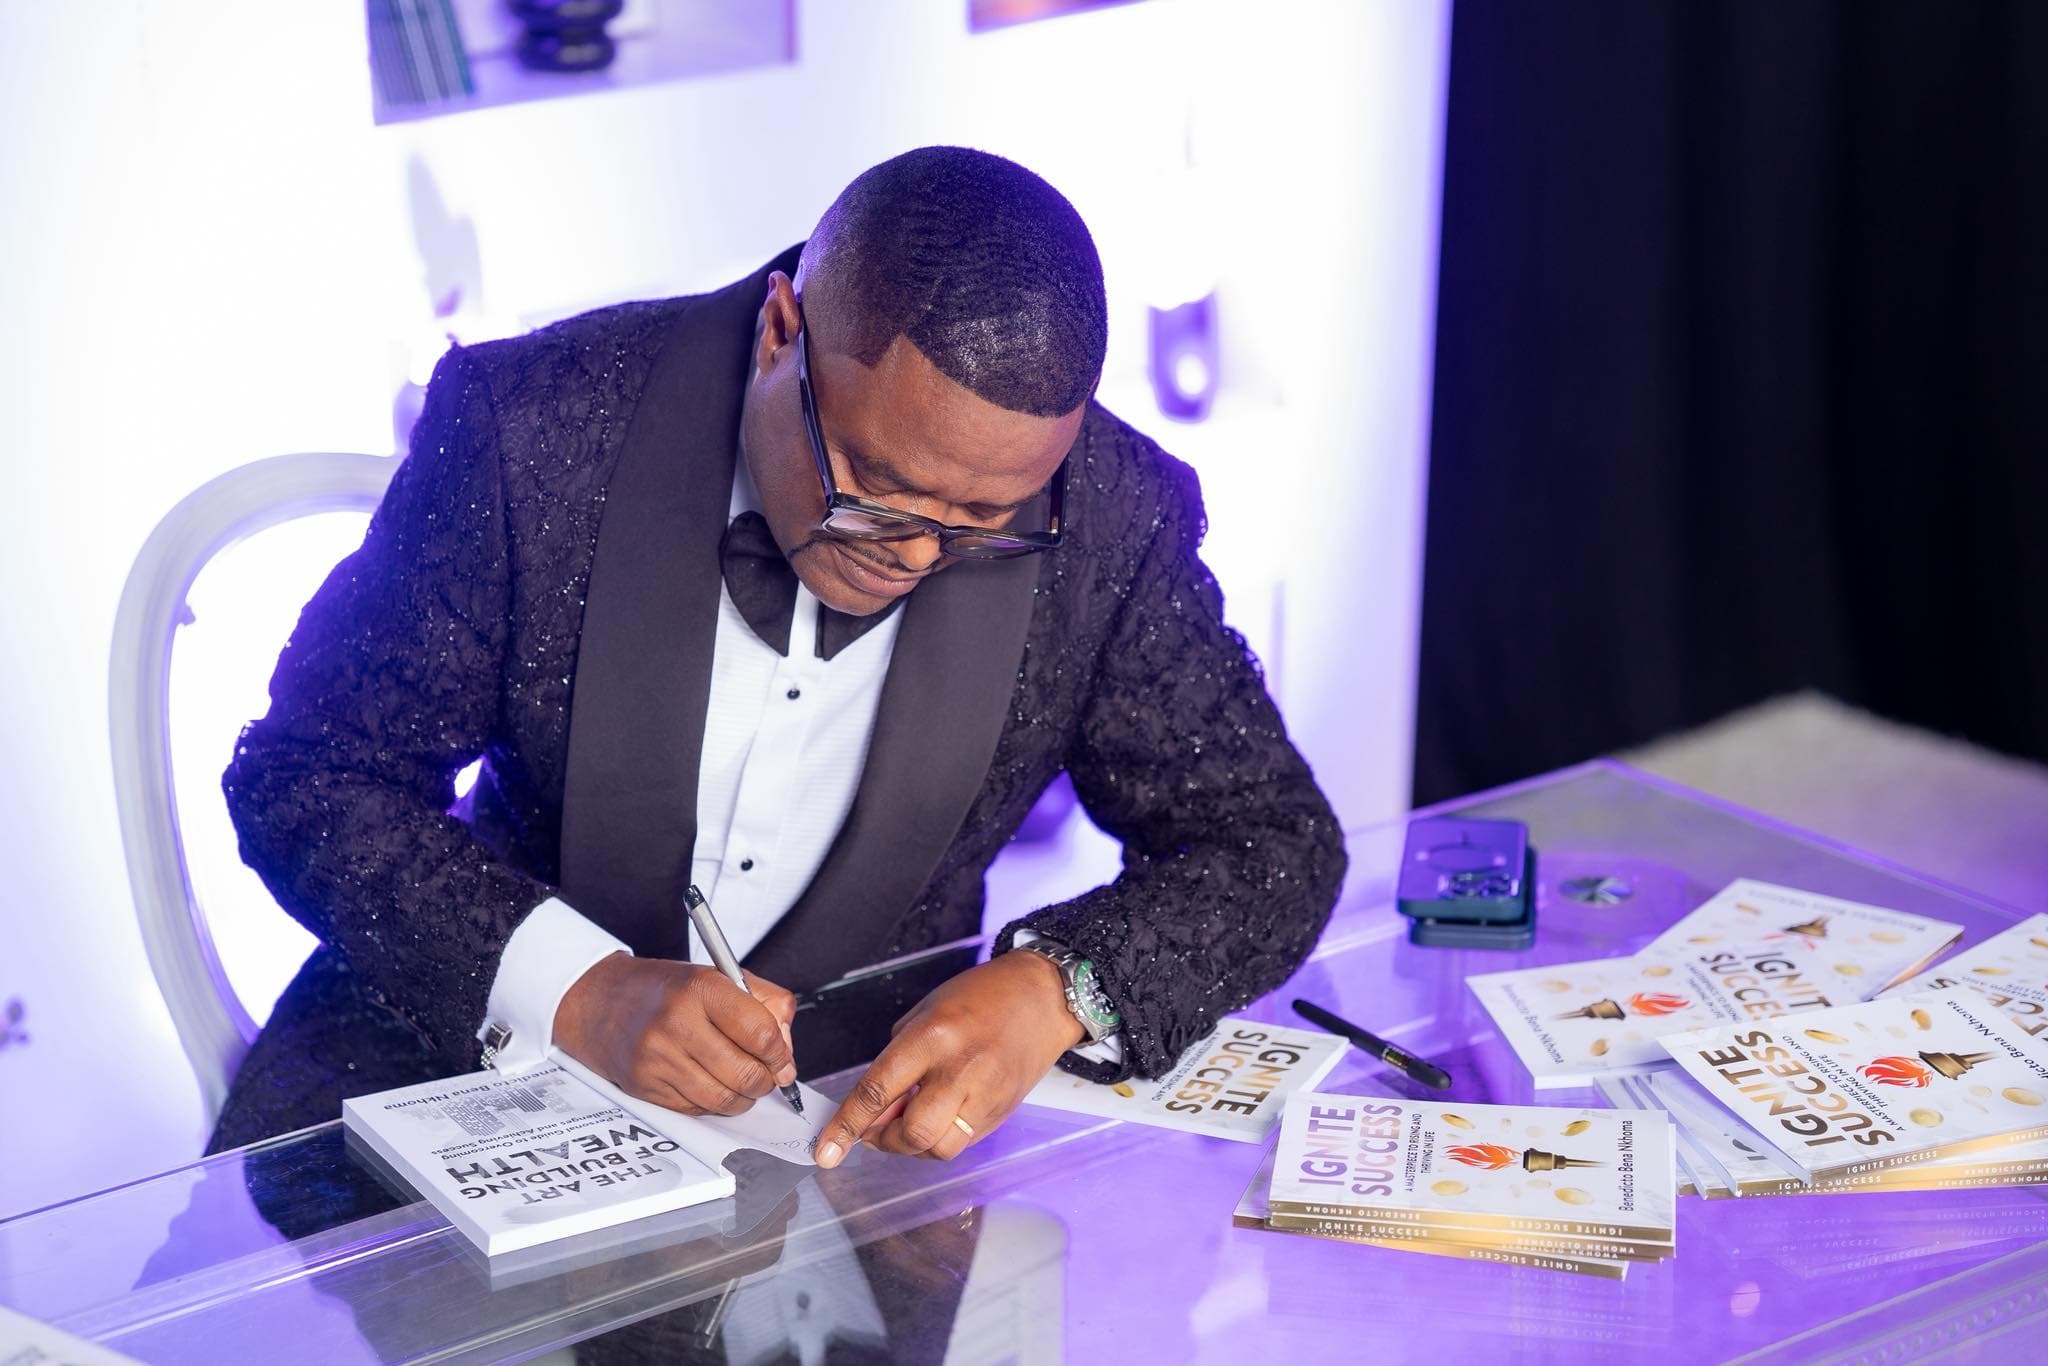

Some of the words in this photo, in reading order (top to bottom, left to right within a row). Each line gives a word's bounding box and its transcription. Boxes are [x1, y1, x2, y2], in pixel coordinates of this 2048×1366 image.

[1700, 953, 1790, 1020] SUCCE
[1745, 952, 1833, 1008] IGNIT
[1947, 1001, 1995, 1037] Nkhoma
[1782, 1035, 1804, 1051] AND
[1994, 1037, 2025, 1058] Bena
[1800, 1051, 1830, 1074] RISING
[1818, 1054, 1839, 1069] LIFE
[1165, 1029, 1268, 1114] SUCCESS
[1210, 1041, 1310, 1115] IGNITE
[1827, 1074, 1842, 1084] TO
[1835, 1068, 1849, 1078] IN
[452, 1085, 491, 1096] Bena
[1699, 1045, 1847, 1146] IGNITE
[1734, 1030, 1895, 1146] SUCCESS
[1846, 1076, 1889, 1108] THRIVING
[383, 1093, 450, 1111] Nkhoma
[1839, 1083, 1898, 1126] MASTERPIECE
[561, 1107, 622, 1126] Challenges
[567, 1116, 614, 1133] Personal
[1412, 1113, 1422, 1125] AND
[478, 1128, 534, 1144] Achieving
[530, 1130, 564, 1141] Guide
[538, 1123, 558, 1132] and
[1410, 1125, 1421, 1143] RISING
[1424, 1131, 1435, 1142] LIFE
[1618, 1120, 1633, 1152] Nkhoma
[2009, 1129, 2048, 1143] BENEDIC
[431, 1140, 477, 1156] Success
[441, 1141, 514, 1161] Overcoming
[446, 1124, 658, 1183] WEALTH
[634, 1140, 680, 1160] OF
[1299, 1106, 1356, 1186] IGNITE
[1351, 1103, 1403, 1196] SUCCESS
[1404, 1152, 1418, 1187] MASTERPIECE
[1420, 1149, 1433, 1174] THRIVING
[1618, 1153, 1633, 1172] Bena
[1846, 1160, 1884, 1174] IGNITE
[1890, 1150, 1937, 1166] SUCCESS
[2028, 1162, 2048, 1170] NKH
[459, 1152, 628, 1199] BUILDING
[590, 1163, 662, 1187] THE
[2003, 1175, 2048, 1183] NKHOMA
[521, 1180, 581, 1205] ART
[1618, 1173, 1634, 1212] Benedicto
[1358, 1209, 1421, 1220] BENEDICTO
[1319, 1221, 1364, 1232] IGNITE
[1371, 1225, 1429, 1237] SUCCESS
[1508, 1220, 1569, 1232] SUCCESS
[1576, 1224, 1623, 1236] IGNITE
[1469, 1249, 1526, 1264] SUCCESS
[1587, 1243, 1636, 1254] NKHOMA
[1534, 1258, 1579, 1272] IGNITE
